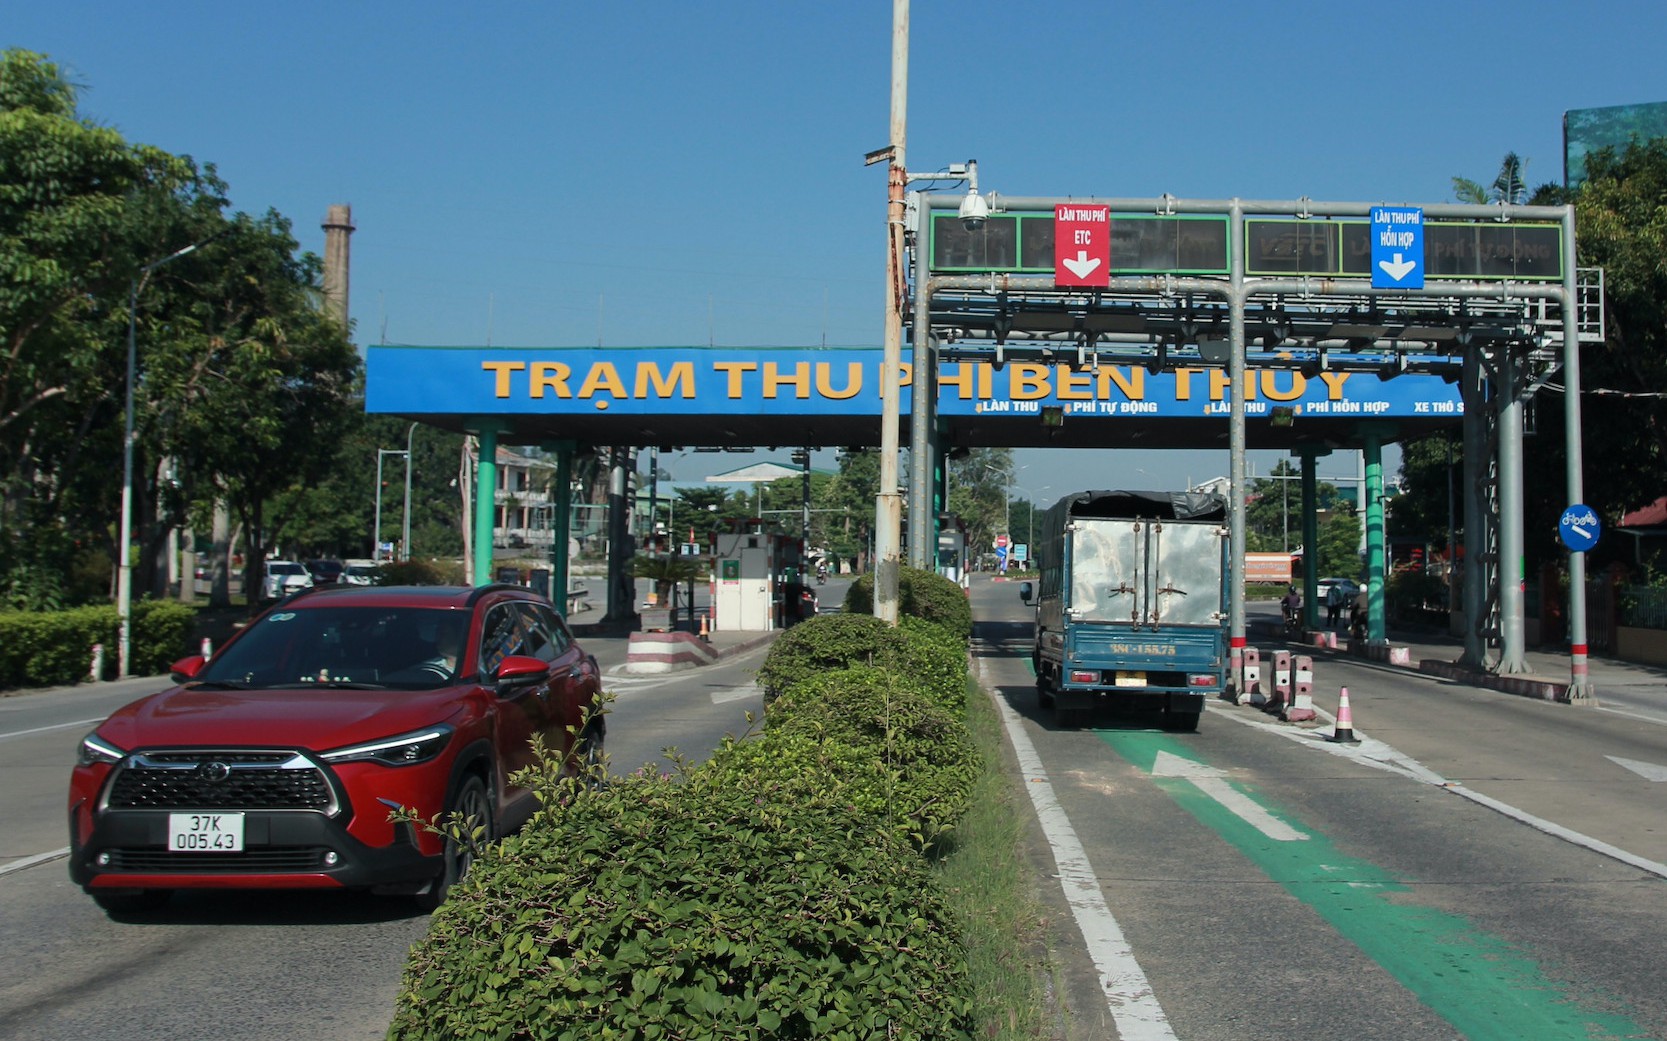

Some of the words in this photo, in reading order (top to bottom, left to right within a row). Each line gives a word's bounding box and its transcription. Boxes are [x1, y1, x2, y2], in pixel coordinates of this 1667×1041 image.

[1058, 207, 1075, 221] LÀN
[1076, 209, 1092, 222] THU
[1092, 208, 1108, 222] PHÍ
[1374, 209, 1390, 224] LÀN
[1391, 212, 1406, 224] THU
[1406, 210, 1421, 224] PHÍ
[1074, 230, 1092, 245] ETC
[1398, 231, 1415, 250] HỢP
[481, 360, 696, 409] TRẠM
[713, 361, 863, 399] THU
[982, 400, 1011, 413] LÀN
[1013, 402, 1039, 413] THU
[1073, 401, 1097, 413] PHÍ
[1099, 401, 1118, 415] TỰ
[1120, 401, 1158, 415] ĐỘNG
[1306, 401, 1331, 413] PHÍ
[1363, 401, 1390, 415] HỢP
[1414, 402, 1431, 413] XE
[1432, 400, 1454, 413] THÔ
[1456, 402, 1465, 413] S
[190, 815, 222, 831] 37K
[177, 833, 235, 849] 005.43
